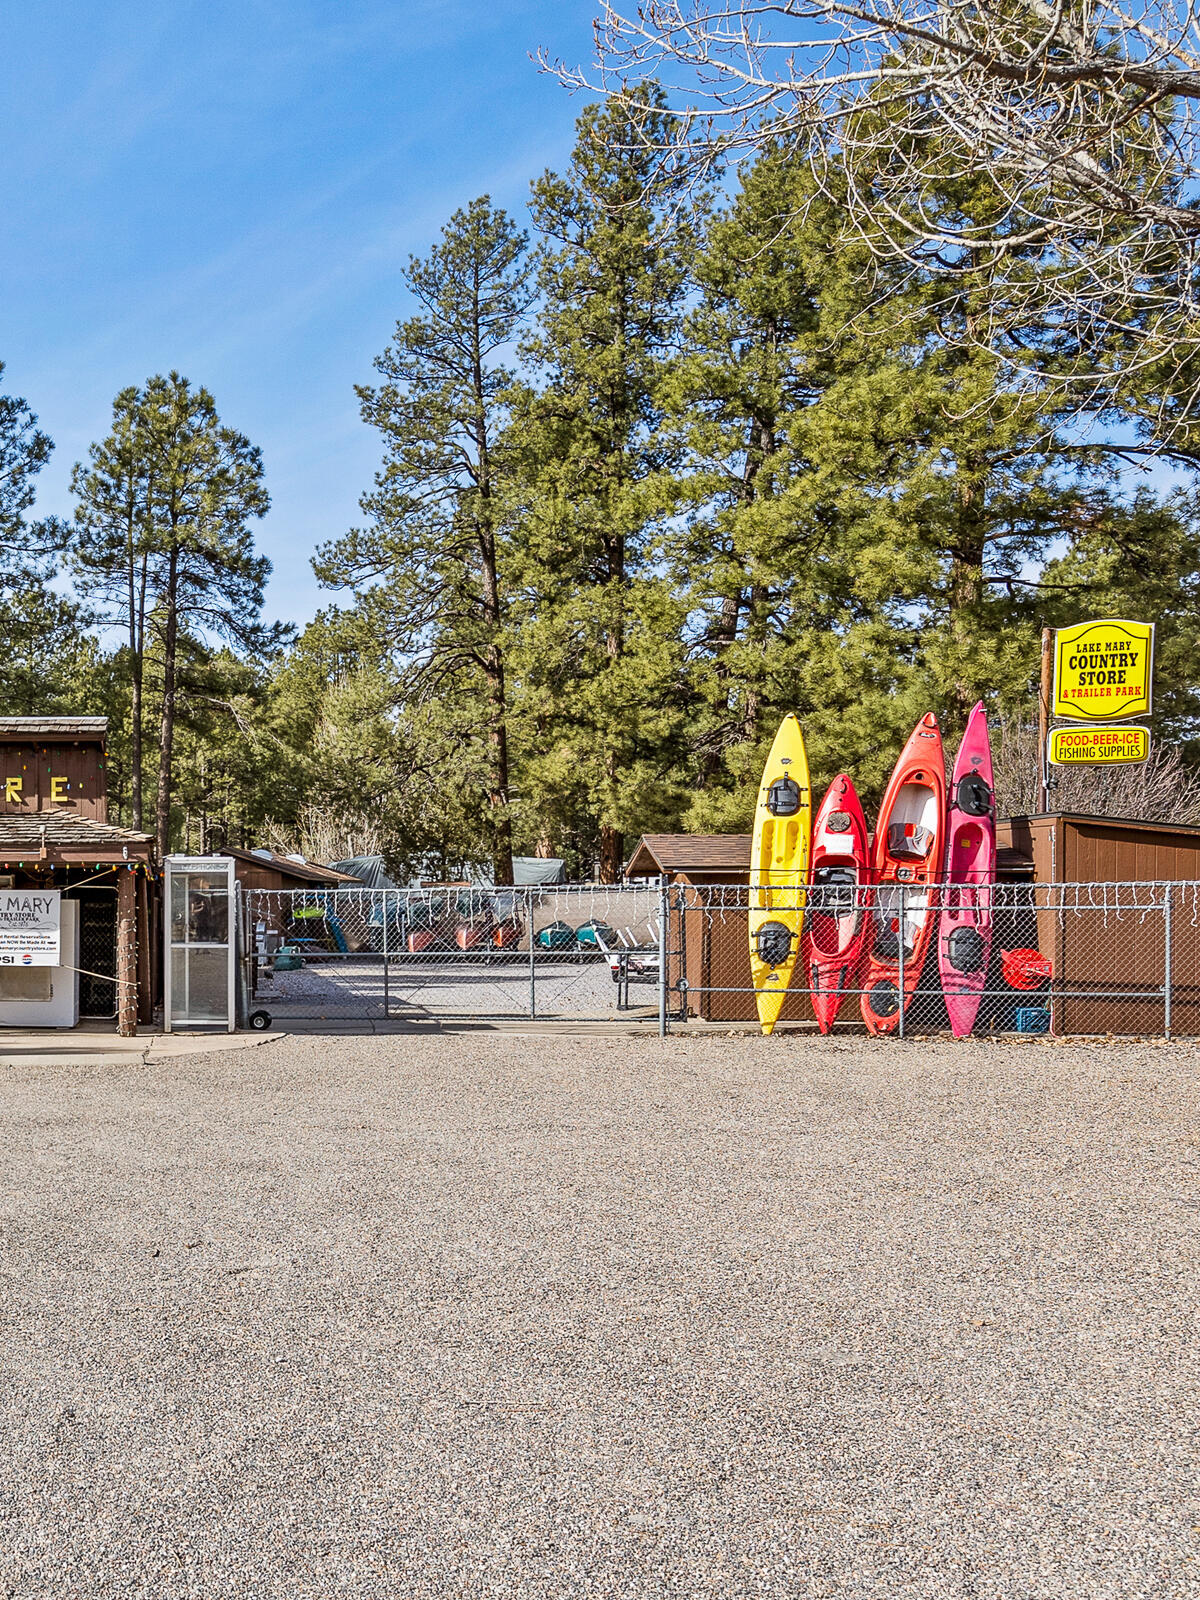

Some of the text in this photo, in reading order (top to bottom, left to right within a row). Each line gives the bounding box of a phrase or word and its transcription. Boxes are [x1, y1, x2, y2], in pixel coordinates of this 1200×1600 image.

[1076, 641, 1132, 654] LAKE MARY
[1069, 653, 1139, 670] COUNTRY
[1078, 670, 1127, 686] STORE
[1062, 686, 1142, 698] & TRAILER PARK
[1060, 733, 1140, 746] FOOD-BEER-ICE
[1058, 745, 1141, 759] FISHING SUPPLIES
[6, 897, 53, 914] MARY
